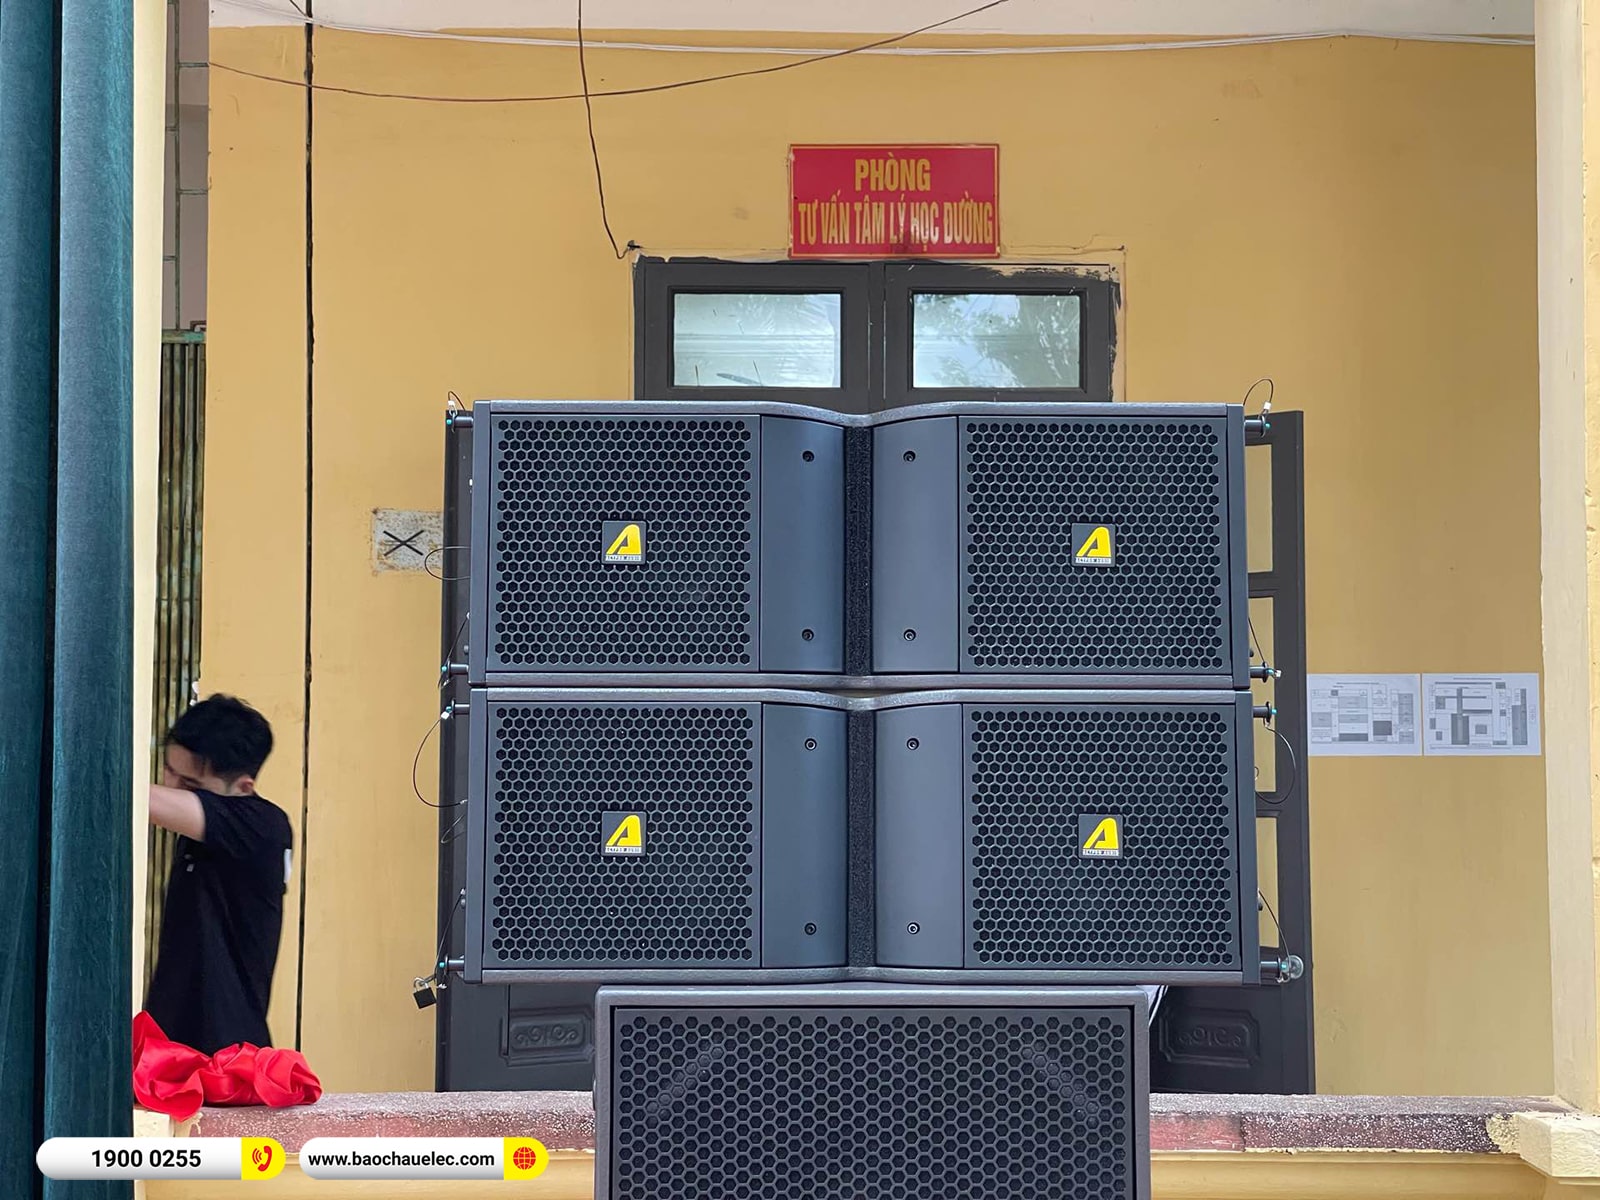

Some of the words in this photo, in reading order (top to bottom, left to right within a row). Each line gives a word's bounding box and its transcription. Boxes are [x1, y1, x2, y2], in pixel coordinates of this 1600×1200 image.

[855, 152, 931, 191] PHÒNG
[798, 199, 818, 245] TƯ
[820, 189, 850, 245] VẤN
[854, 194, 885, 245] TÂM
[889, 193, 905, 245] LÝ
[910, 201, 940, 252] HỌC
[943, 190, 994, 245] ĐƯỜNG
